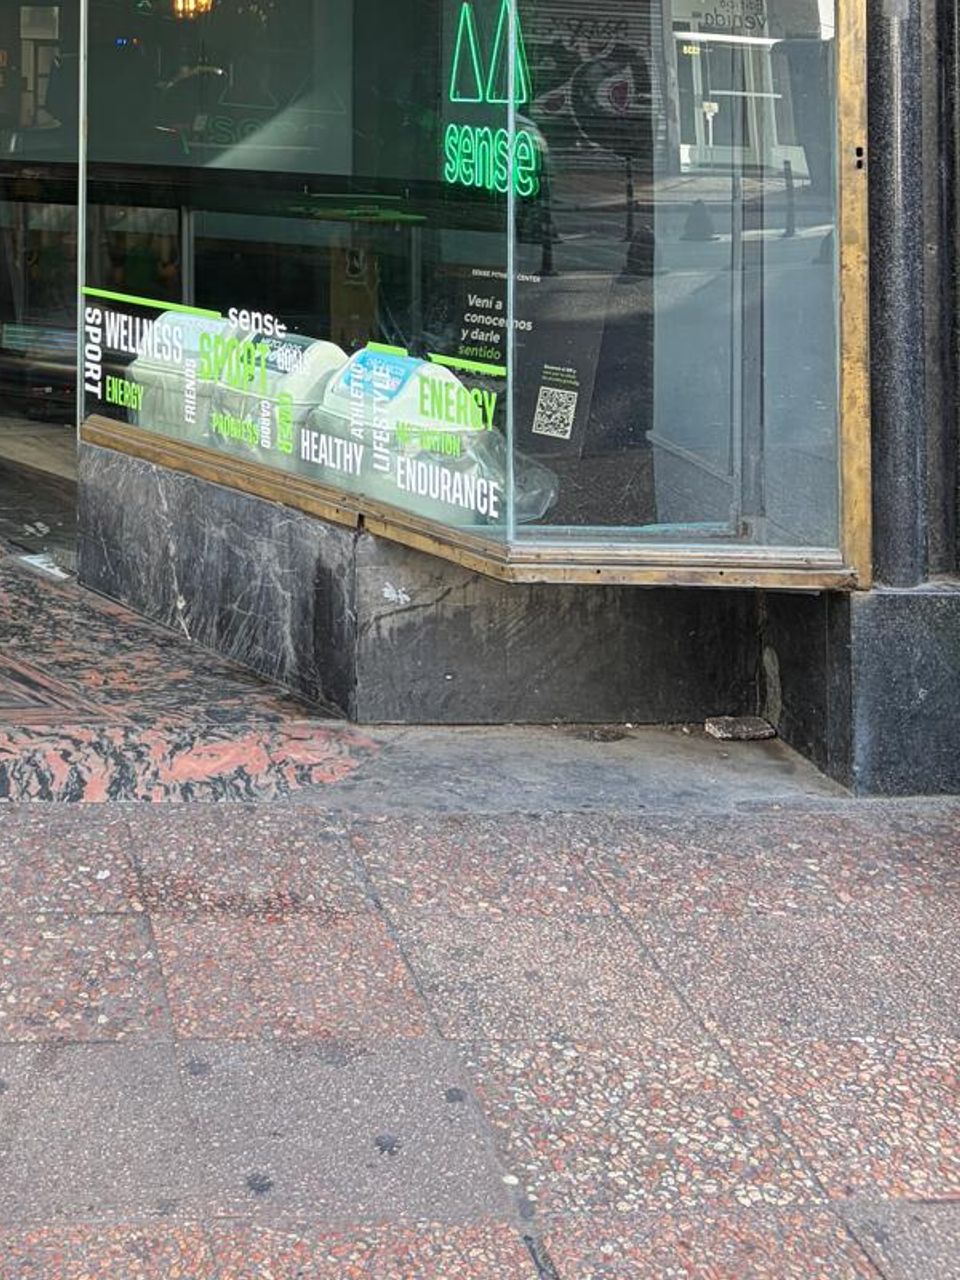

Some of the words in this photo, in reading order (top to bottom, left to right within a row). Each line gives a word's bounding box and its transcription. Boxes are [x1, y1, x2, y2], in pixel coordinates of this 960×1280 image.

[443, 124, 538, 198] sense
[228, 307, 287, 338] sense
[464, 312, 533, 332] conocenos
[495, 300, 503, 310] a
[84, 307, 102, 400] SPORT
[105, 311, 182, 363] WELLNESS
[458, 345, 501, 360] sentido
[461, 328, 470, 341] y
[470, 328, 501, 344] darle
[105, 375, 144, 410] ENERGY
[183, 358, 197, 424] FRIENDS
[417, 374, 497, 432] ENERGY
[261, 400, 273, 450] CARDIO
[300, 428, 364, 476] HEALTHY
[396, 456, 499, 519] ENDURANCE
